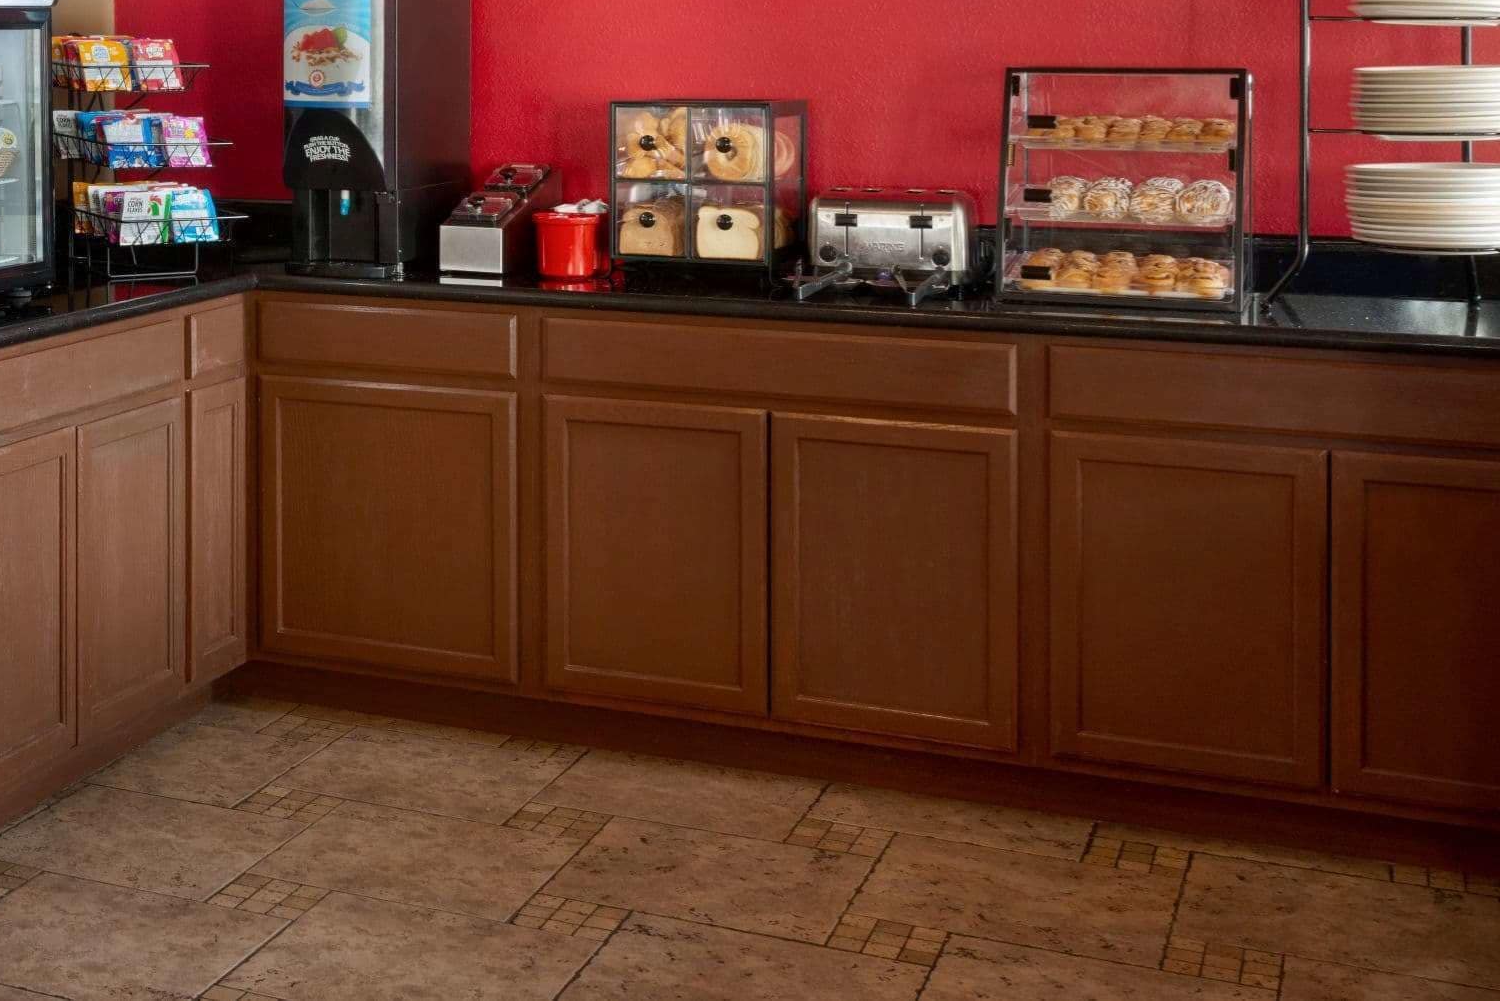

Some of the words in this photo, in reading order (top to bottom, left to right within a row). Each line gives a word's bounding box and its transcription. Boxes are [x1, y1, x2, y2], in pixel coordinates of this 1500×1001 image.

[305, 145, 331, 158] ENJOY
[332, 145, 351, 157] THE
[127, 200, 143, 208] CORN
